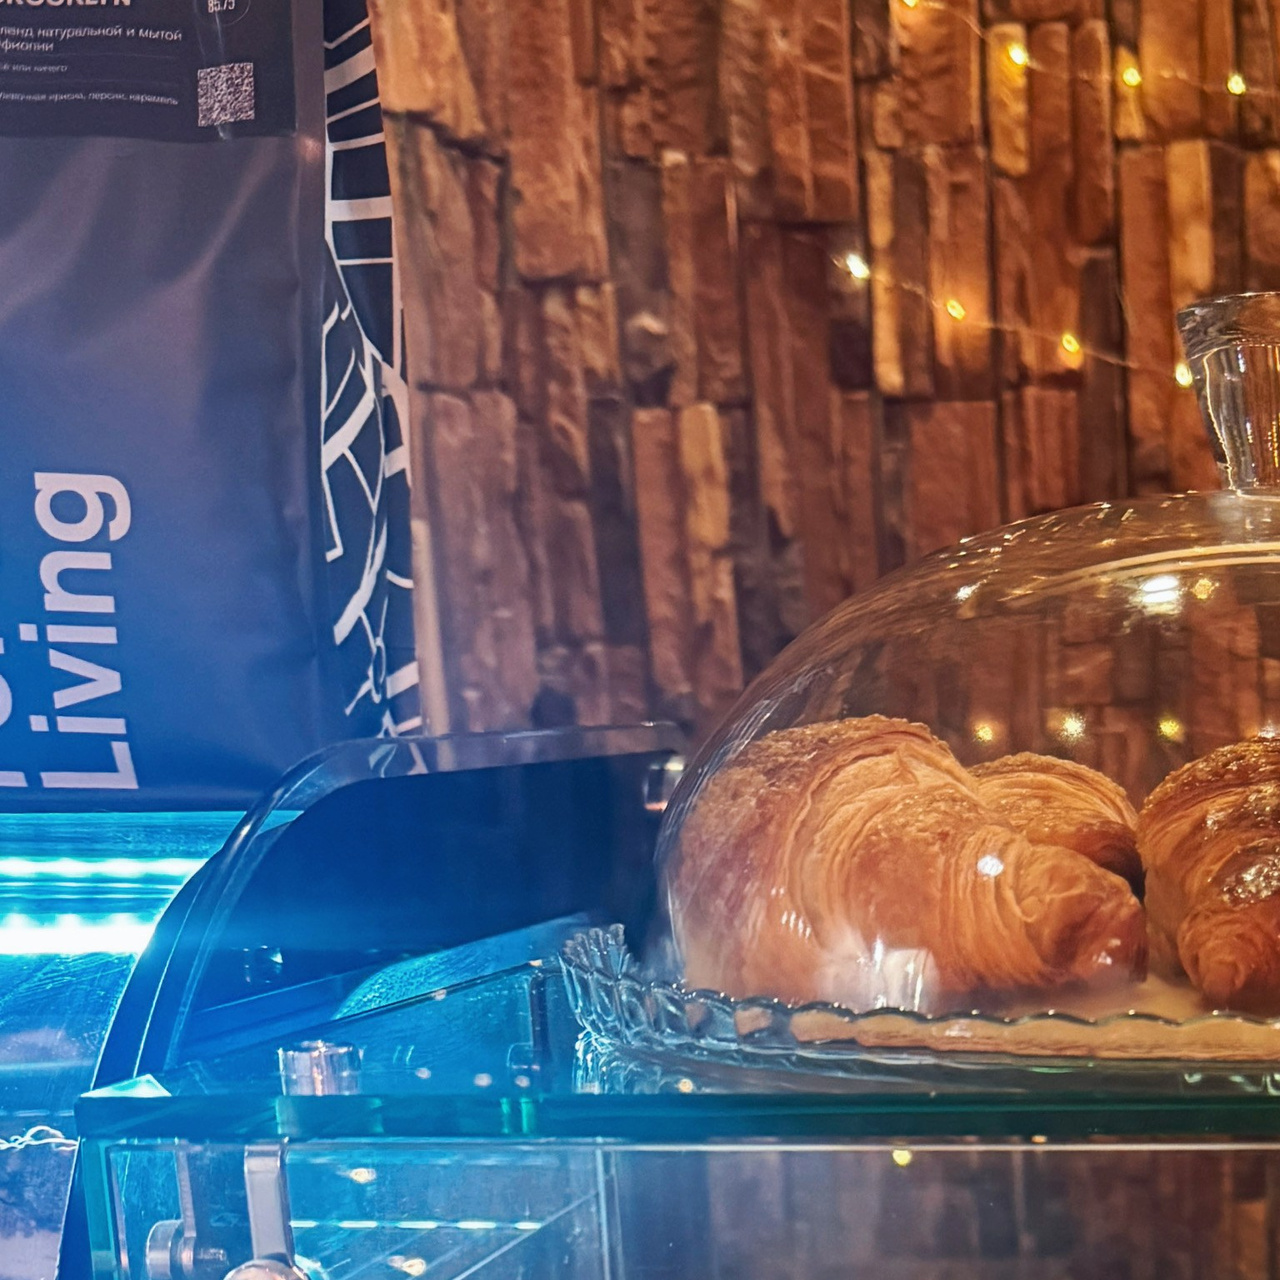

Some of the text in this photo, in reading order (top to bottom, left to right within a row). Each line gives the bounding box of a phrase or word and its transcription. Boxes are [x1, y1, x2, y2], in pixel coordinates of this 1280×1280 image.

[38, 25, 122, 41] натуральной
[126, 27, 135, 37] и
[139, 28, 182, 41] мытой
[0, 38, 54, 53] фиопии
[19, 472, 139, 788] Living
